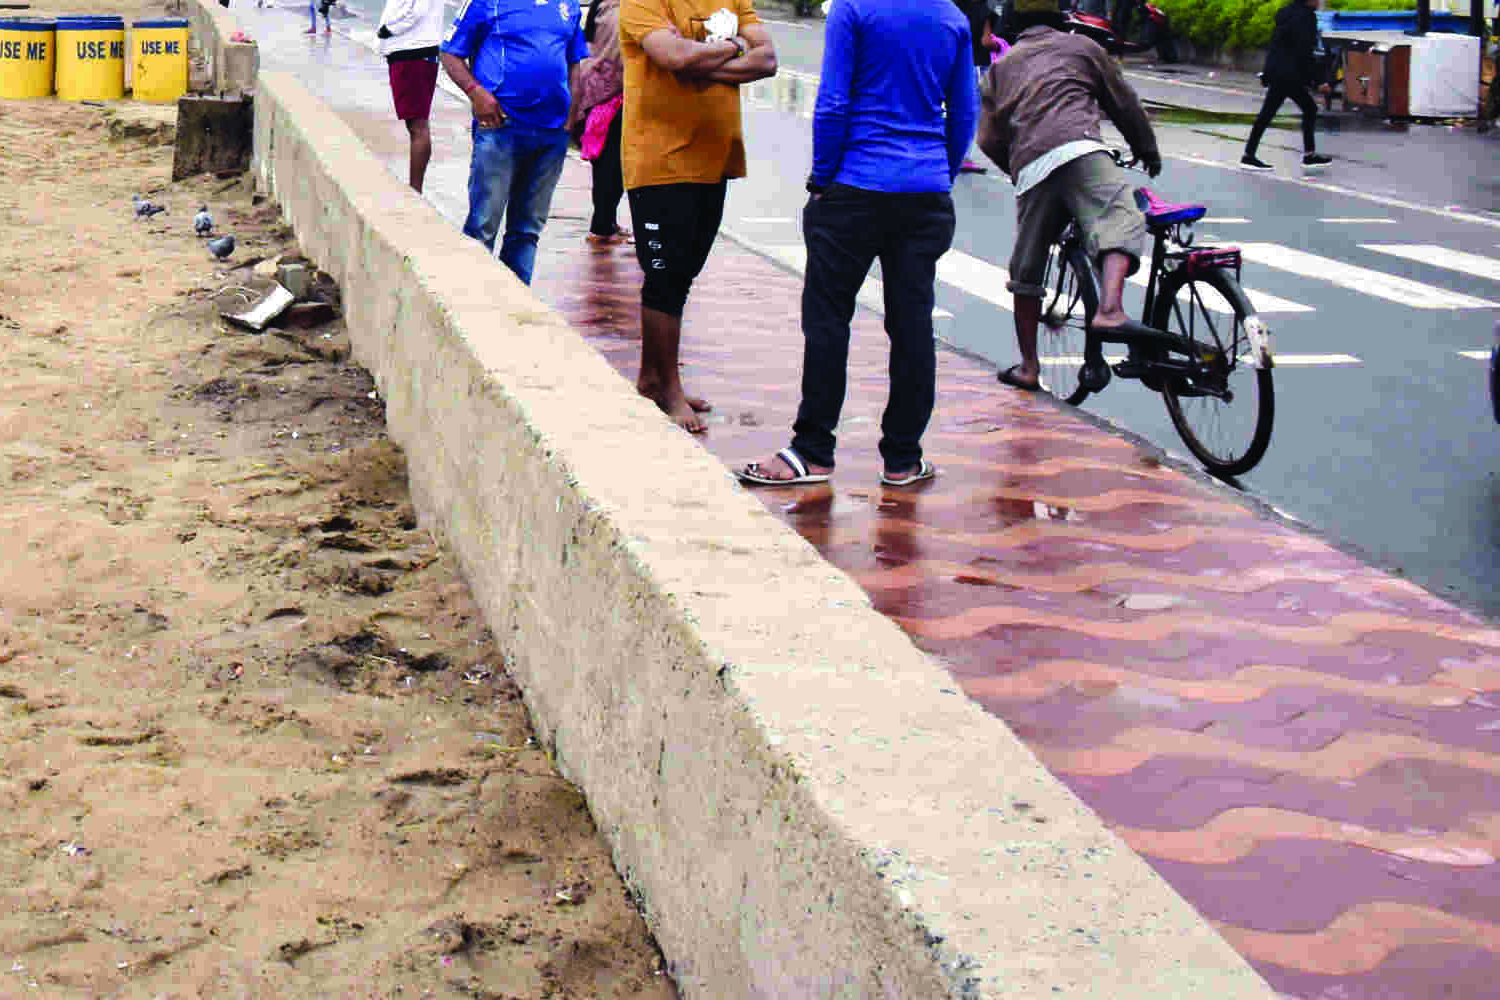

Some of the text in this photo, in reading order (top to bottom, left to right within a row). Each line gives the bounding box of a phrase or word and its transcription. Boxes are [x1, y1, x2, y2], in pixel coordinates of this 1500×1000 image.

[26, 41, 46, 60] ME
[76, 41, 106, 59] USE
[140, 41, 181, 55] USE ME
